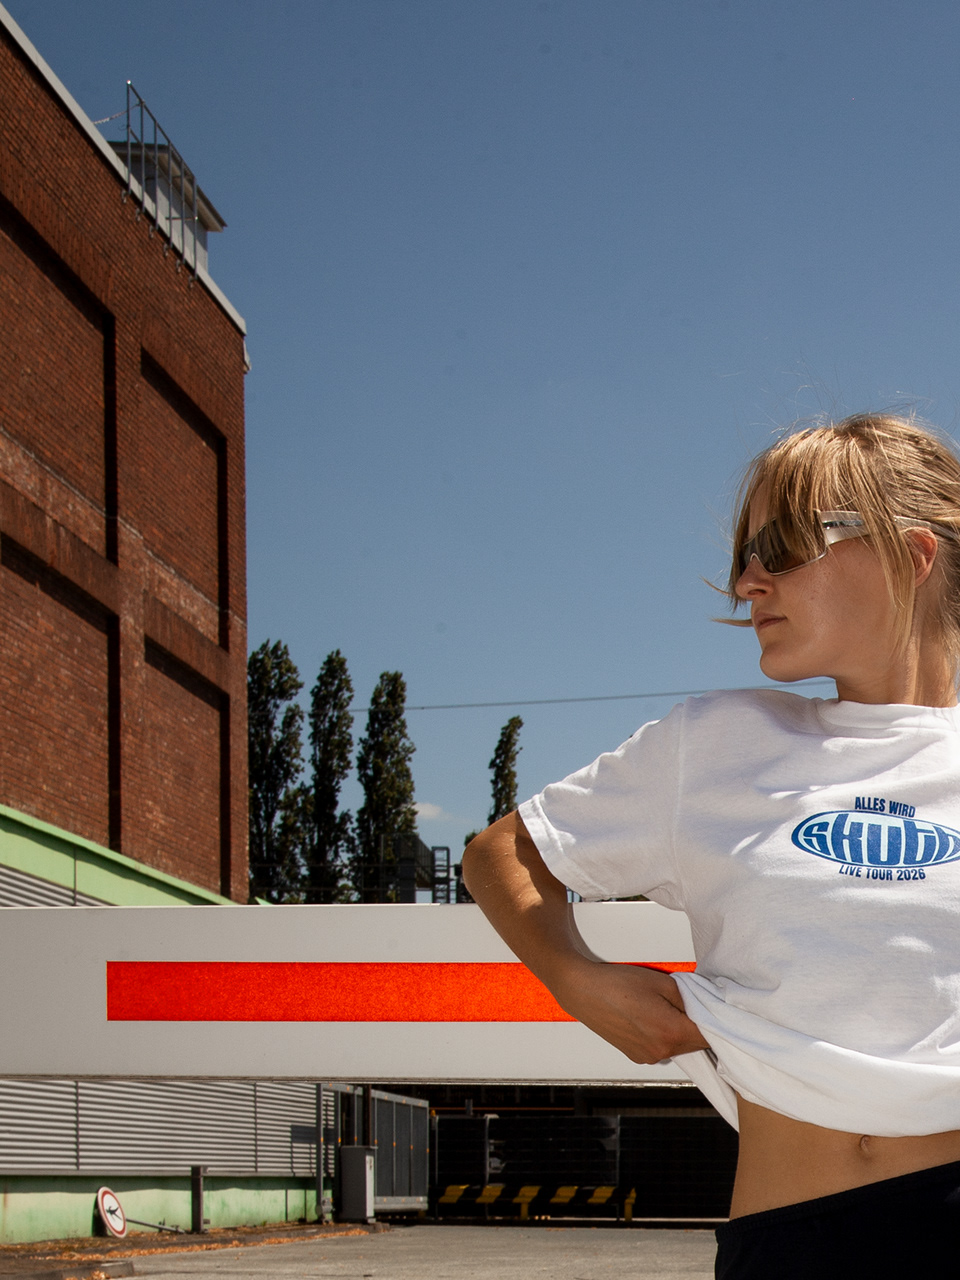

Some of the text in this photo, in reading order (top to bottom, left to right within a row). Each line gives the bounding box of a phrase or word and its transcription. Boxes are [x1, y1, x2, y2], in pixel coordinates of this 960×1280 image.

[854, 796, 916, 818] ALLES WIRD
[838, 864, 926, 881] LIVE TOUR 2026
